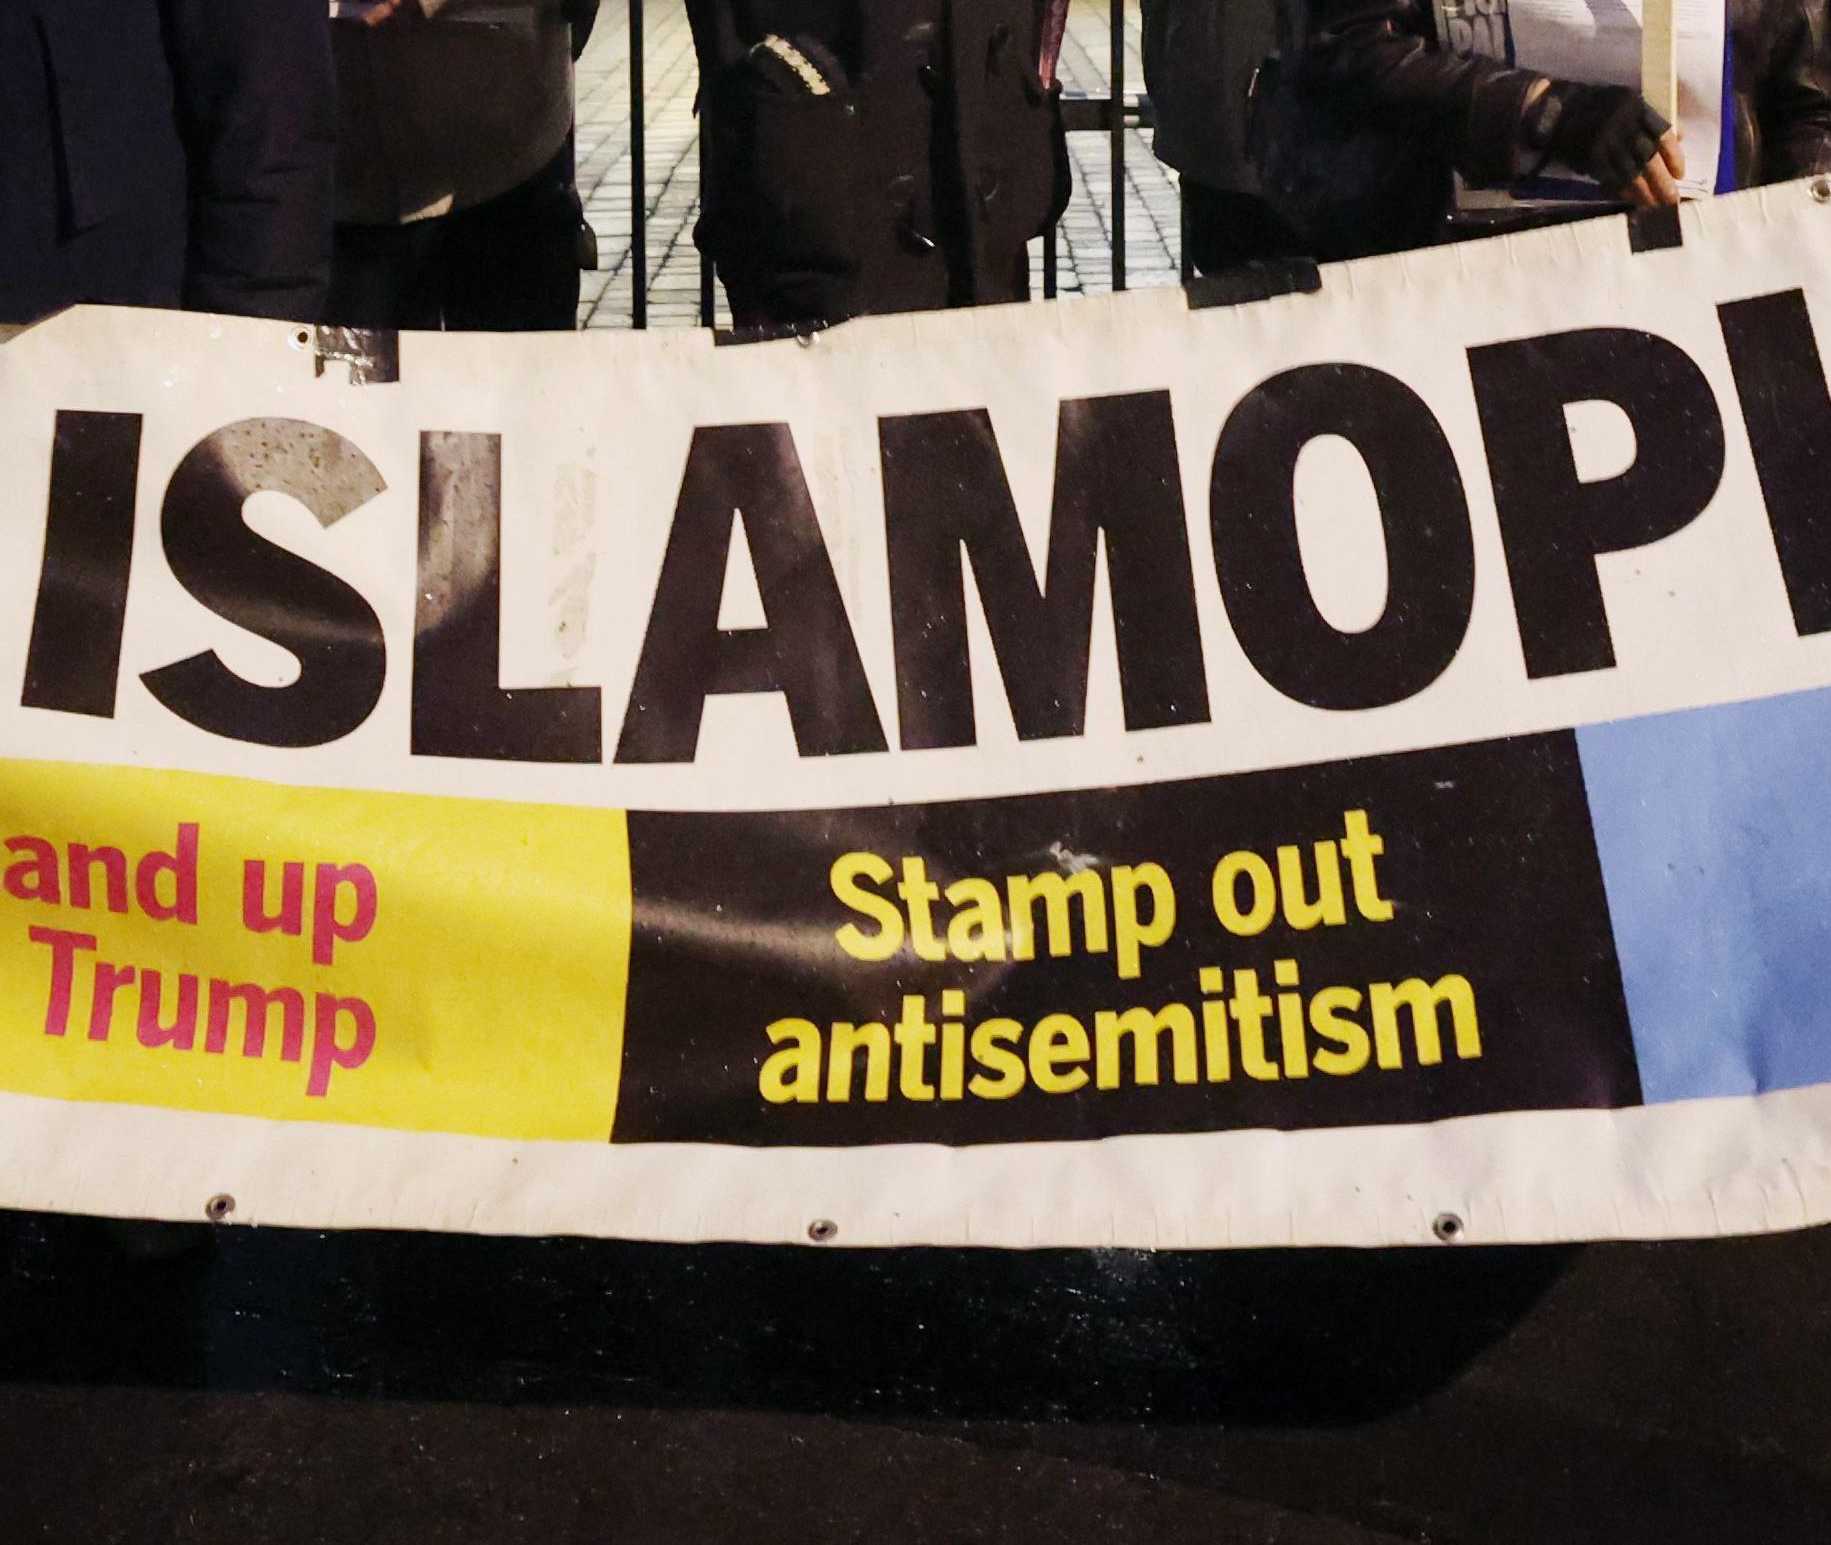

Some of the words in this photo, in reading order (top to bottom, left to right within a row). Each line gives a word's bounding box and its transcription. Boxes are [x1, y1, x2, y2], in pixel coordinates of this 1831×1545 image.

[240, 839, 381, 944] up
[829, 851, 1177, 980] Stamp
[1211, 809, 1396, 941] out
[40, 933, 381, 1099] Trump
[759, 962, 1483, 1105] antisemitism
